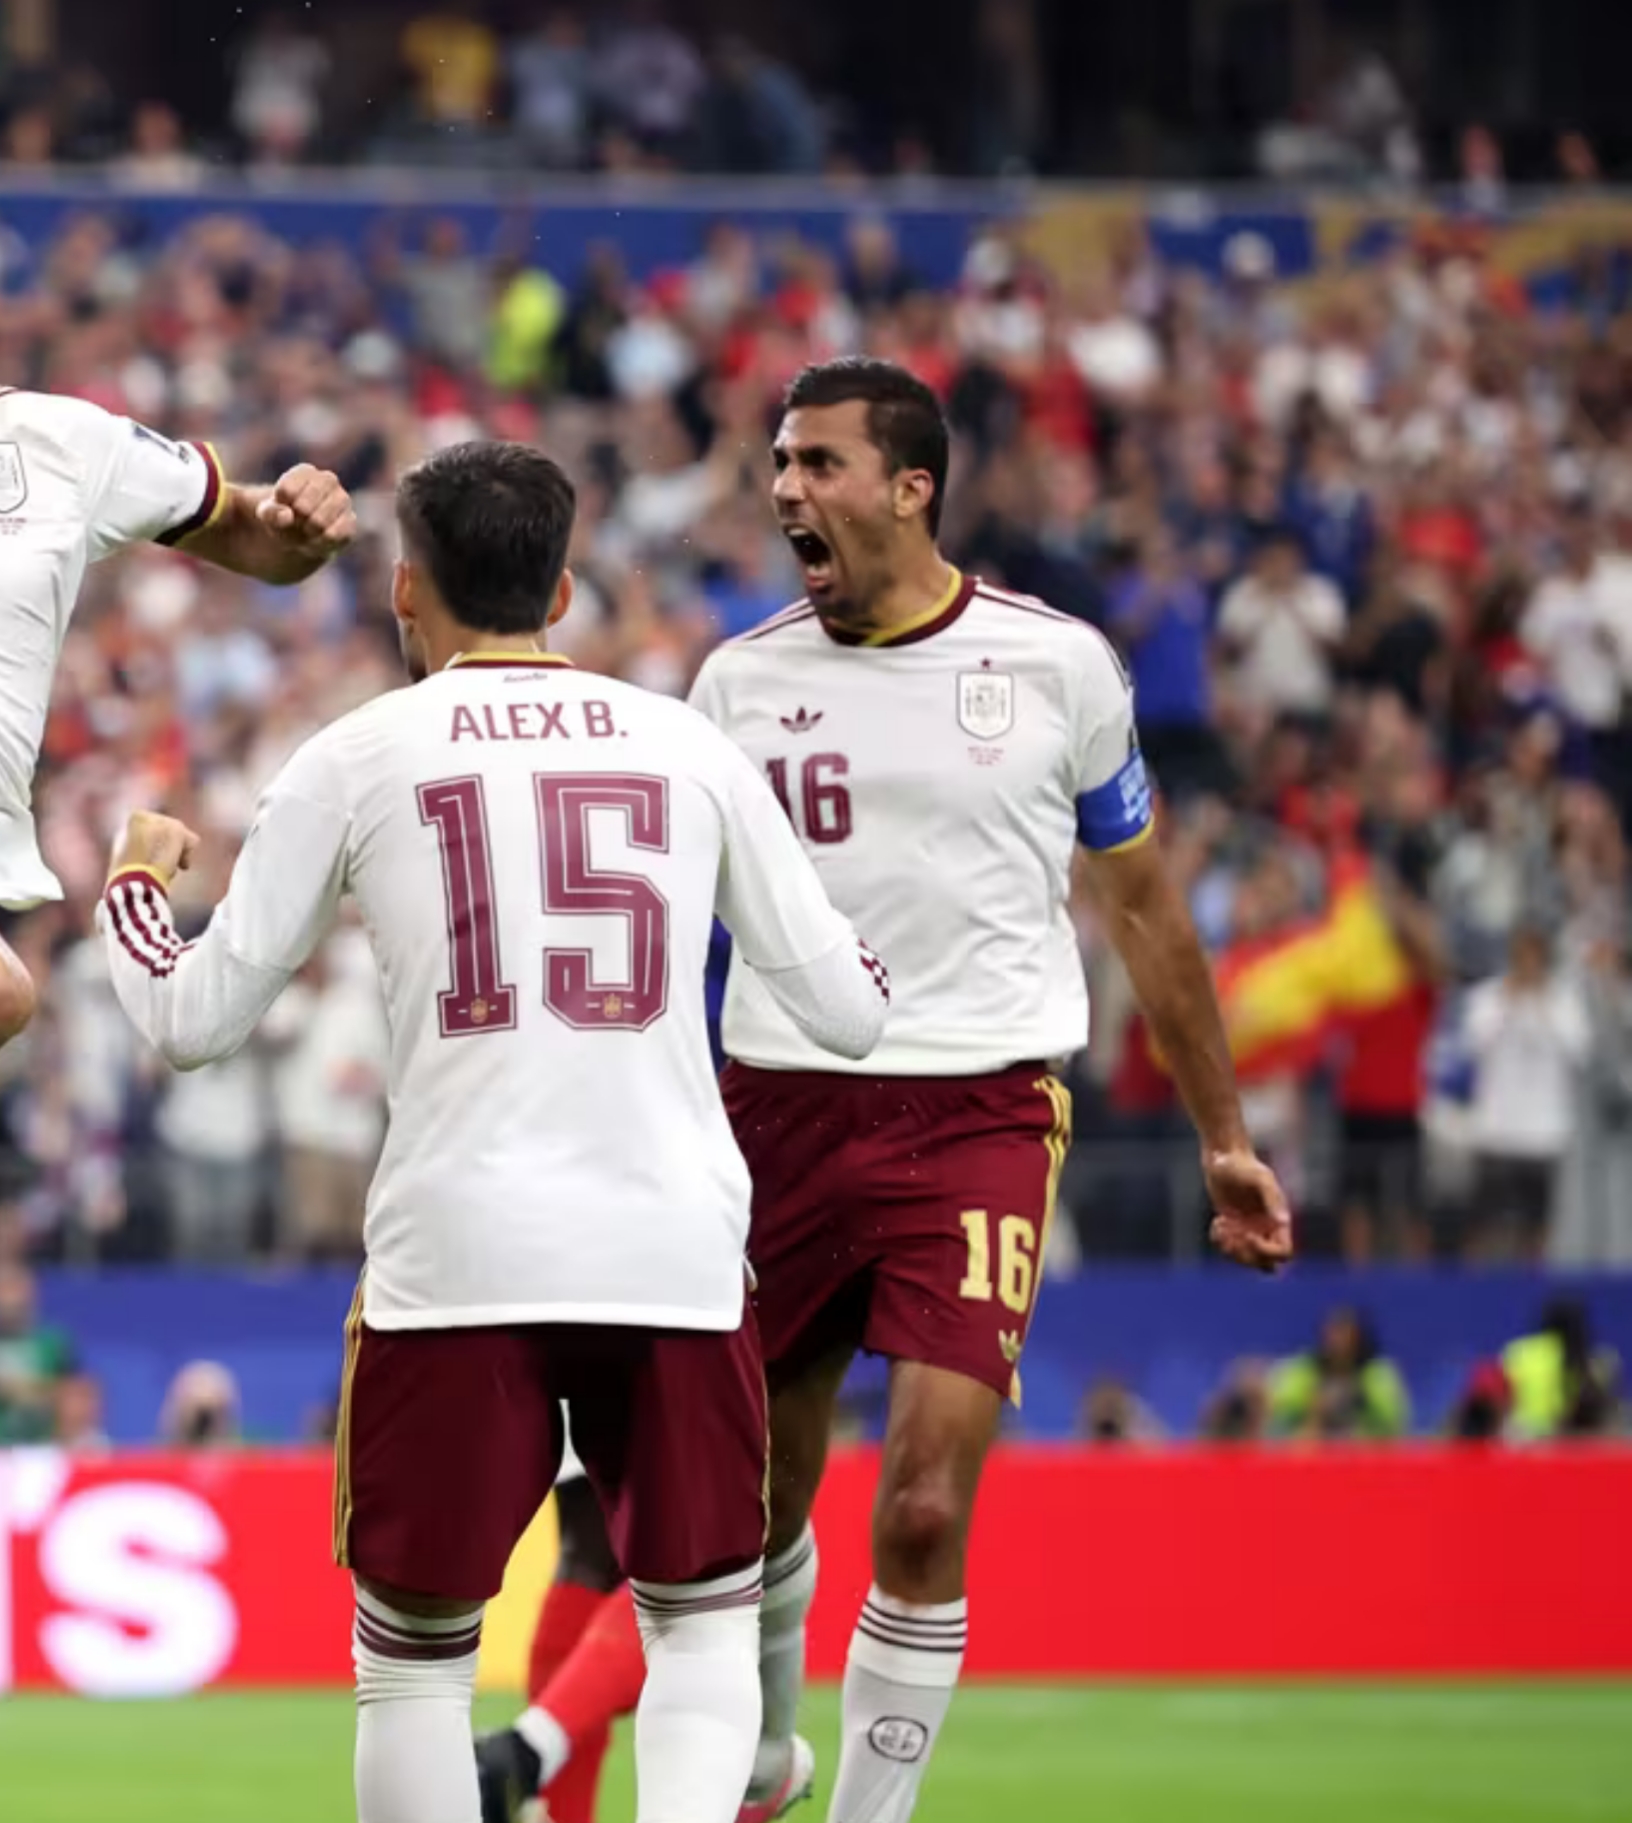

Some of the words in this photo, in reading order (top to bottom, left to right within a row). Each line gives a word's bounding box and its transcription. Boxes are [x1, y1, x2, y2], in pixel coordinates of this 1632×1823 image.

[450, 702, 570, 742] ALEX
[582, 700, 628, 738] B.
[415, 771, 670, 1038] 15
[959, 1208, 1036, 1314] 16
